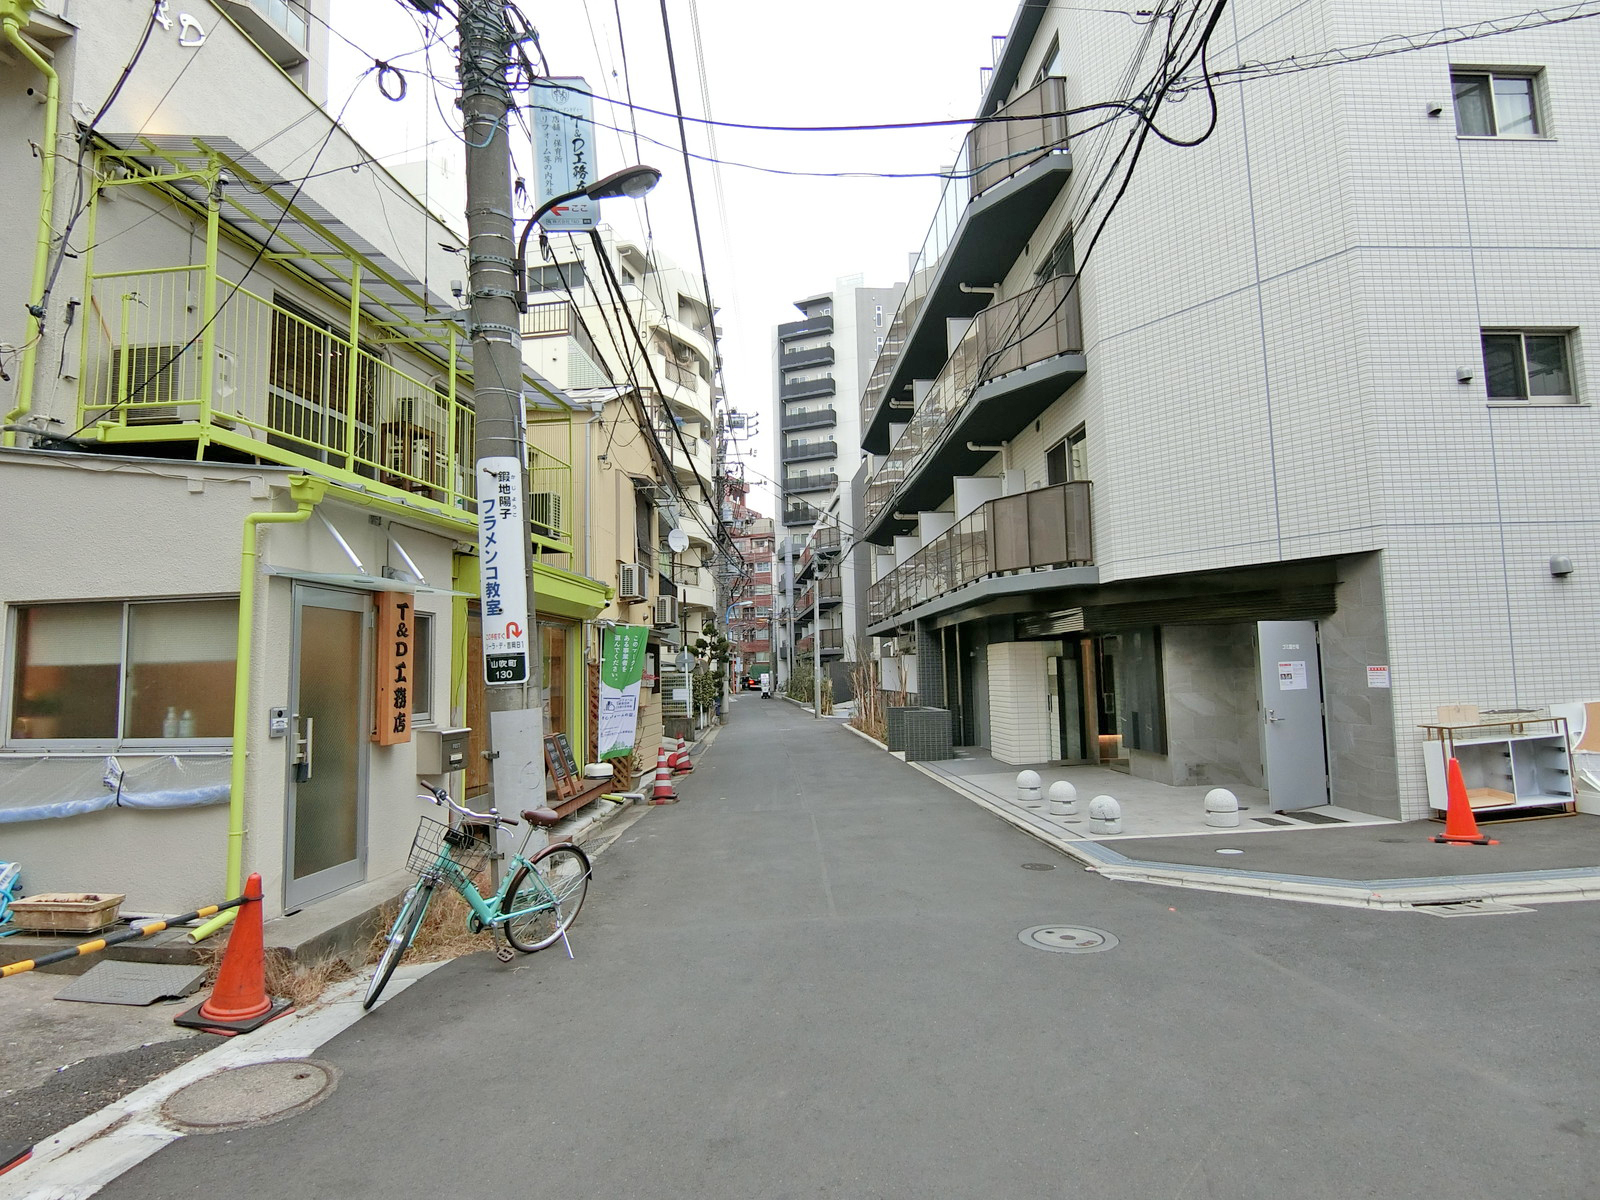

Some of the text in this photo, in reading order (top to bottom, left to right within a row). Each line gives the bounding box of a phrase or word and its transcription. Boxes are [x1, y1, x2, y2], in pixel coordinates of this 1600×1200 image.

[552, 116, 563, 163] 店舗・保育所
[571, 204, 589, 213] ここ
[482, 498, 502, 616] フラメンコ教室
[393, 602, 409, 734] T&D工務店
[490, 659, 517, 669] 山吹町
[495, 670, 513, 679] 130
